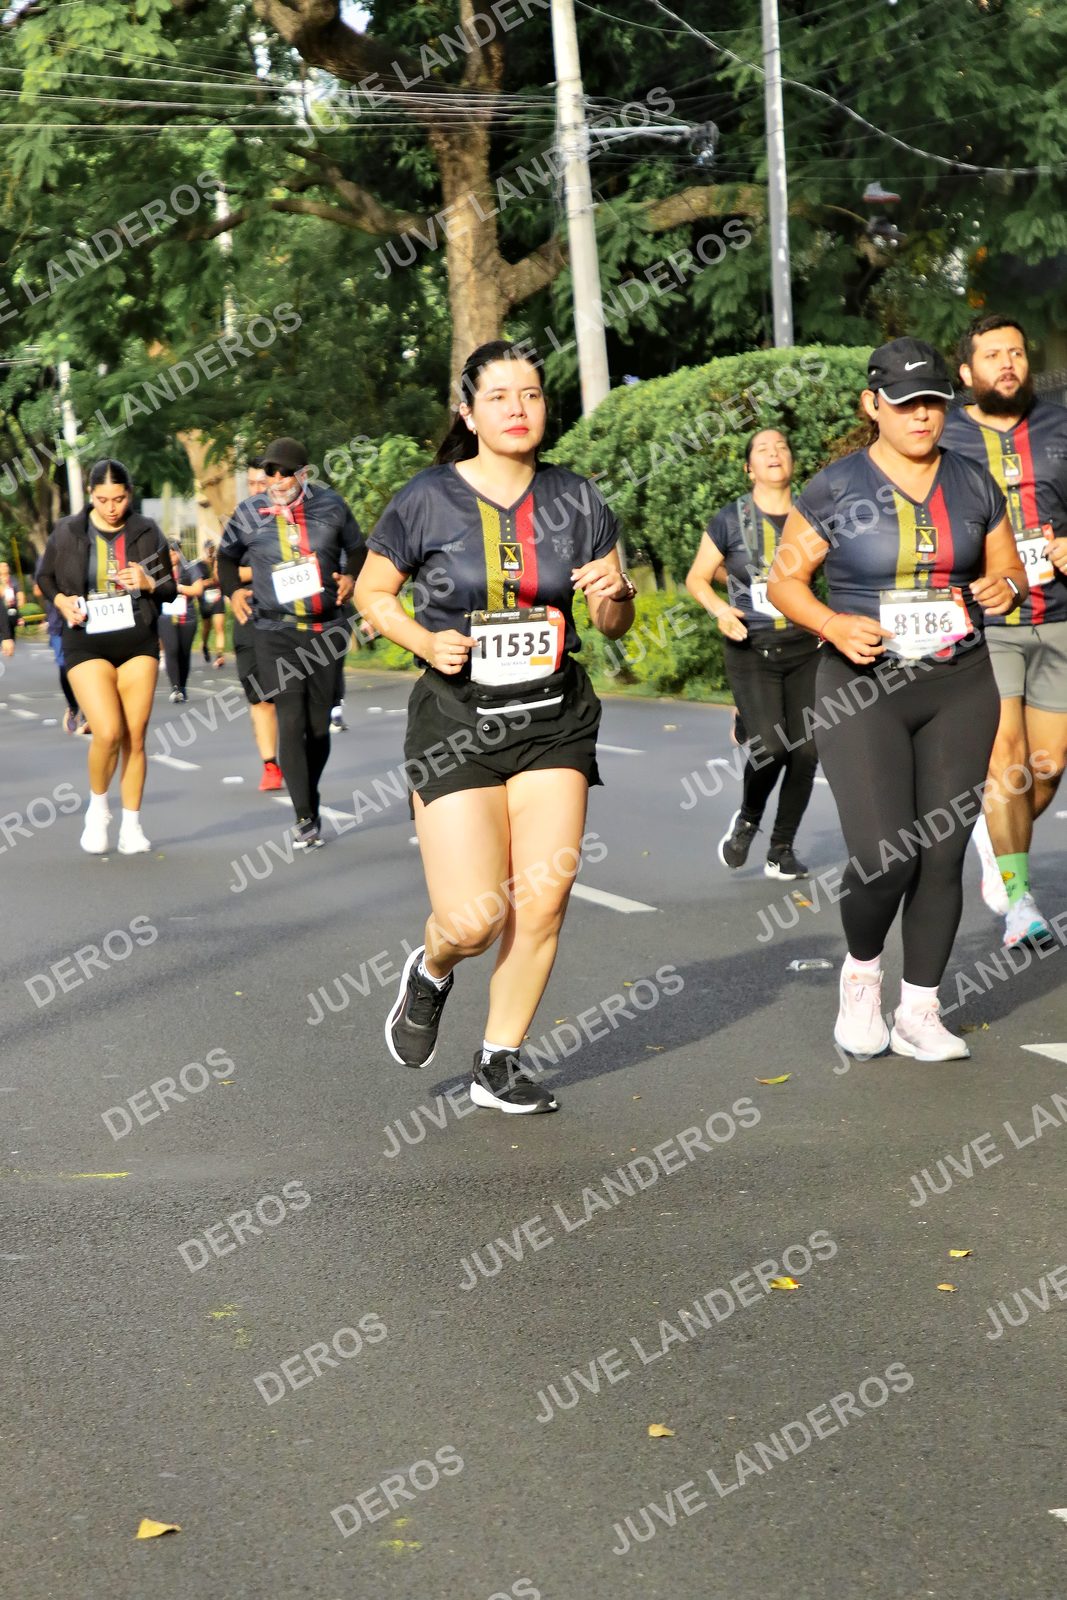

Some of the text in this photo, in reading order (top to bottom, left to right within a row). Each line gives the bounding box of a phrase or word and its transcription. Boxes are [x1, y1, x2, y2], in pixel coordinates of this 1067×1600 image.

[94, 602, 125, 617] 1014
[894, 611, 953, 635] 8186
[477, 630, 551, 659] 11535
